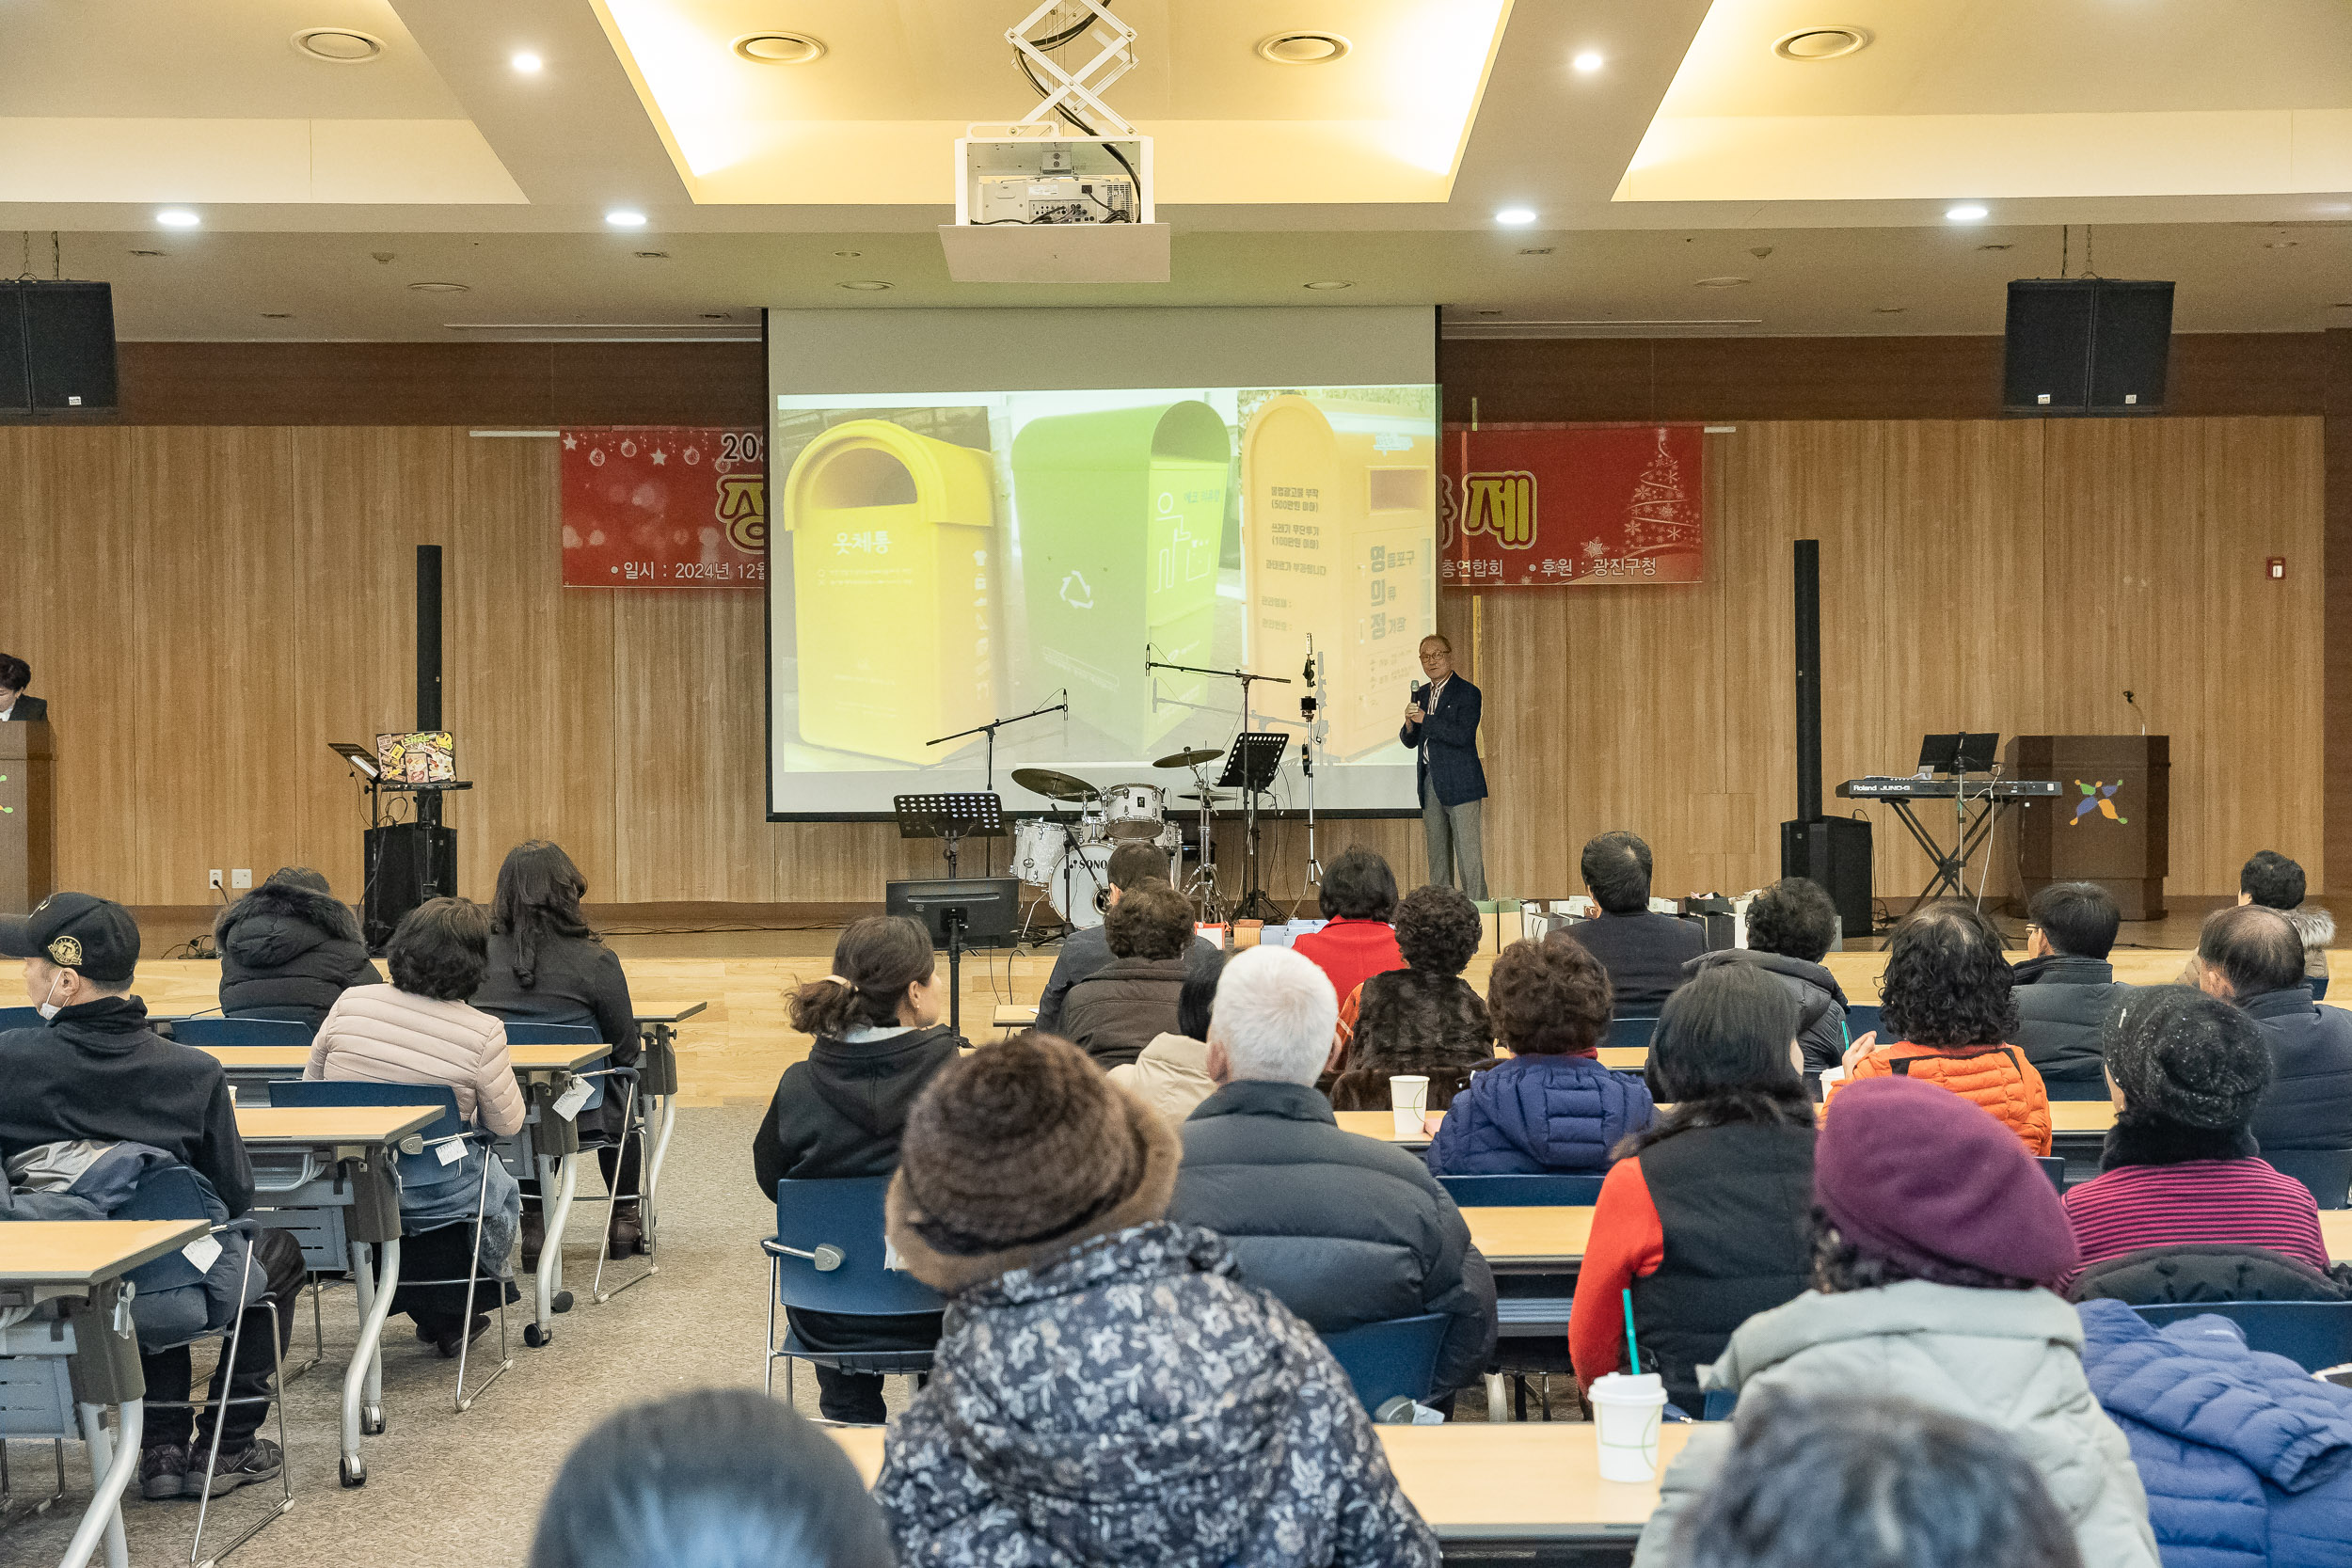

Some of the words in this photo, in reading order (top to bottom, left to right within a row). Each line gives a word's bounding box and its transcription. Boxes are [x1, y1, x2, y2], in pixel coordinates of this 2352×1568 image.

[722, 433, 763, 462] 20
[1272, 523, 1291, 533] 쓰레기
[1293, 525, 1319, 535] 무단투기
[624, 562, 655, 579] 일시
[675, 562, 729, 580] 2024년
[1541, 558, 1573, 577] 후원
[1593, 557, 1656, 577] 광진구청
[62, 944, 72, 956] T
